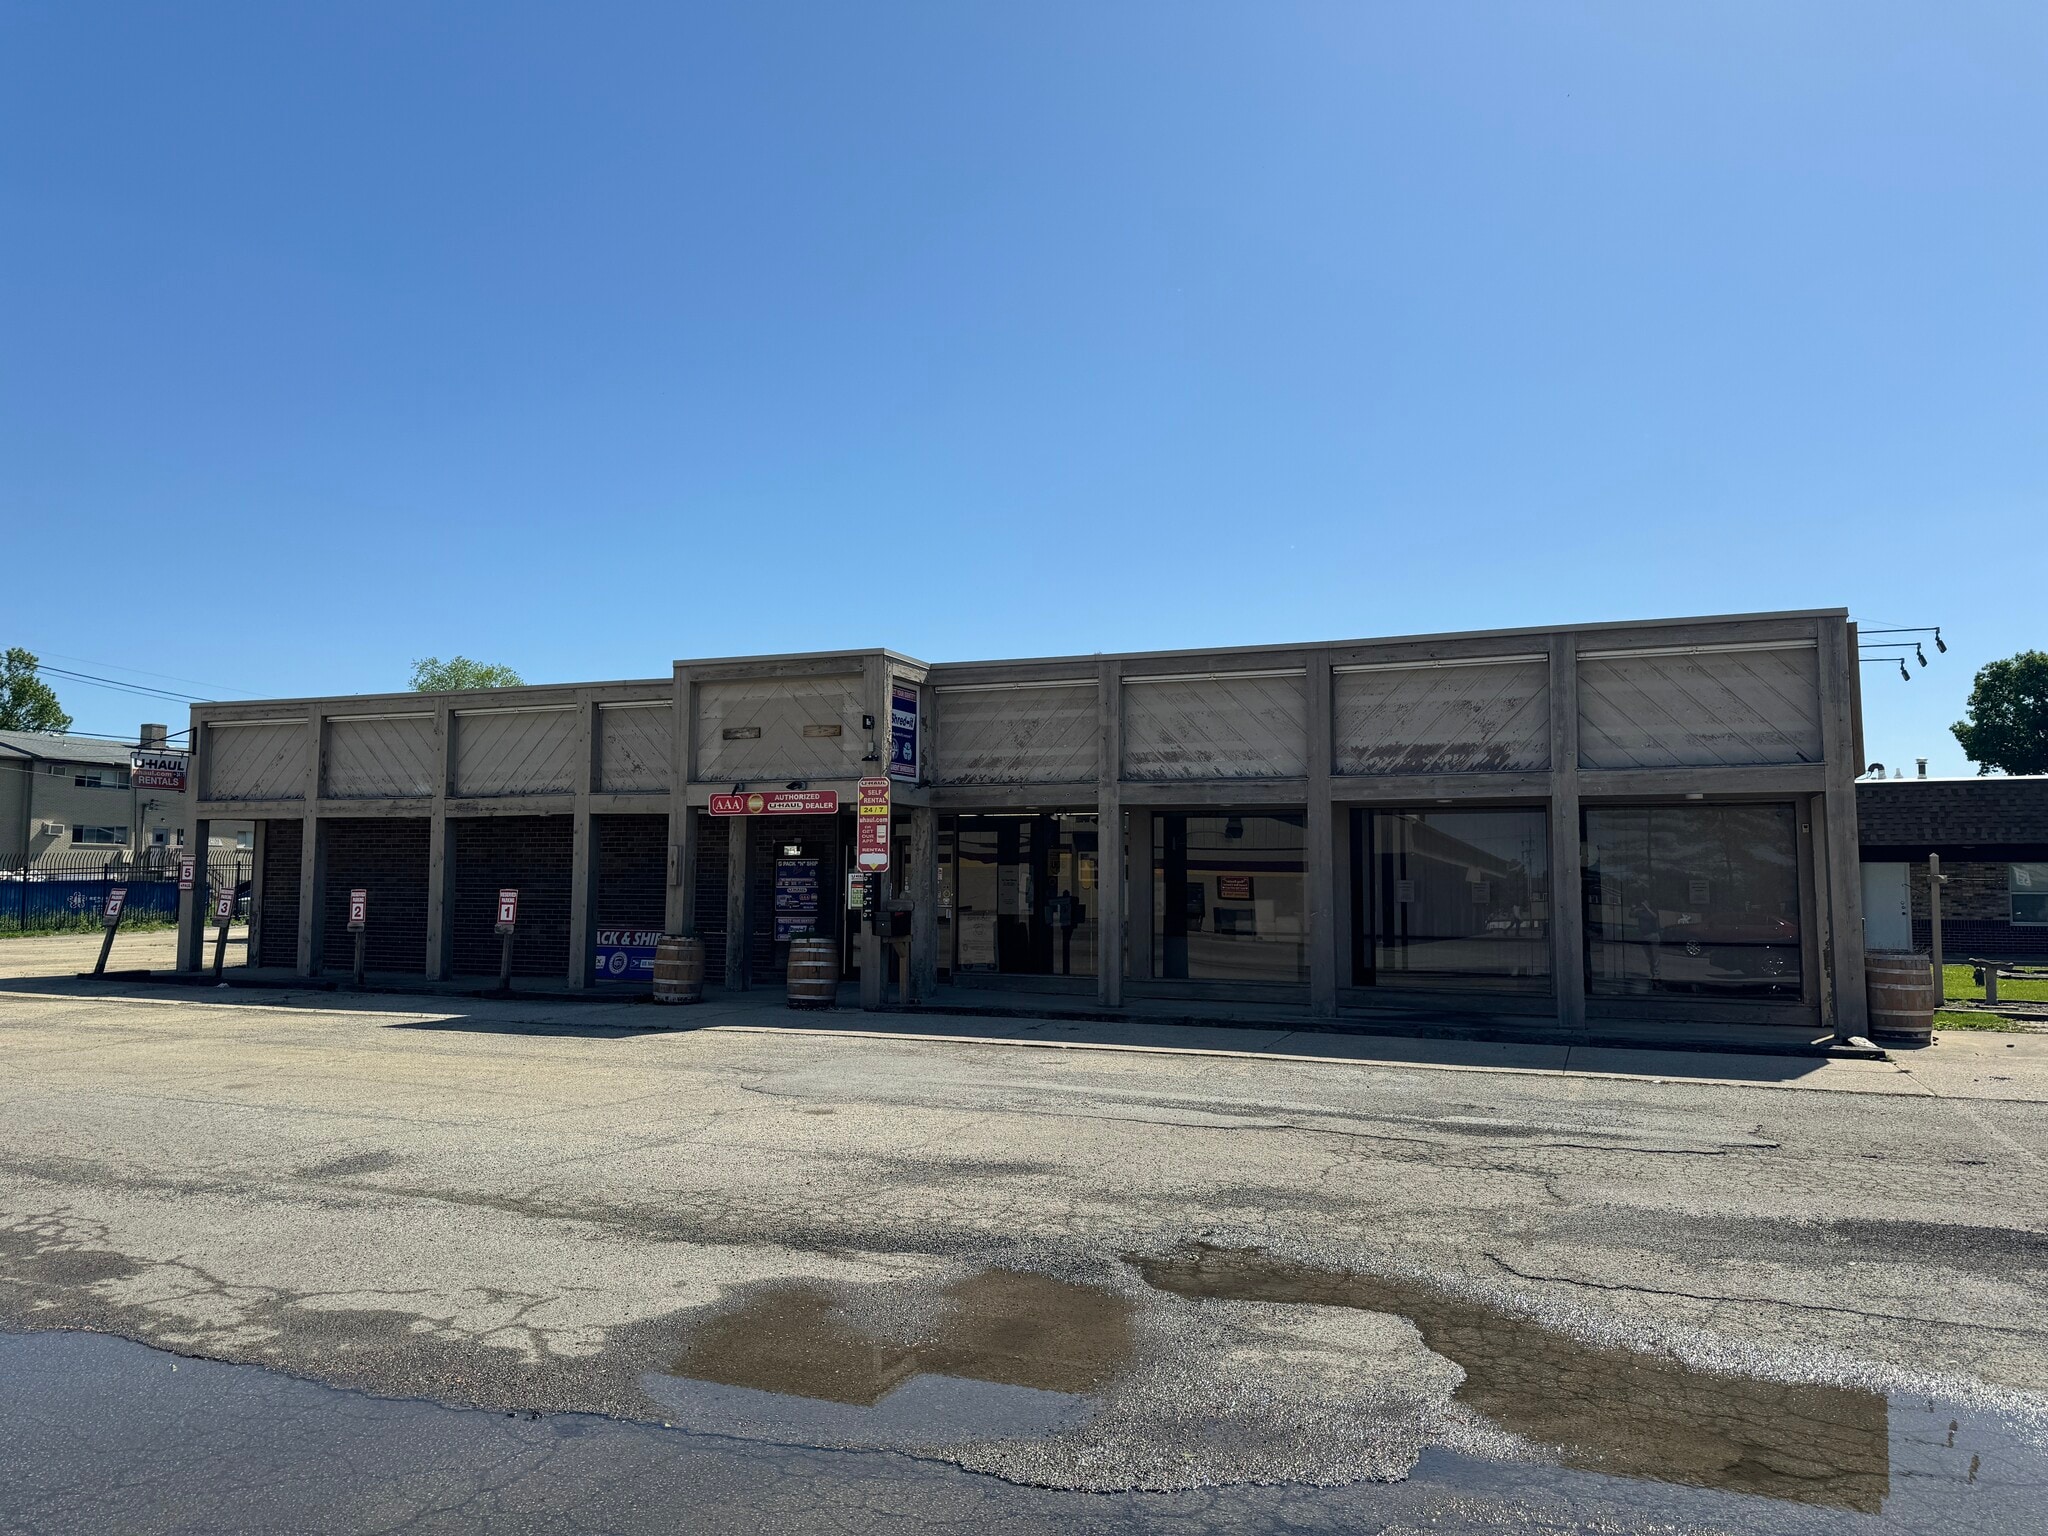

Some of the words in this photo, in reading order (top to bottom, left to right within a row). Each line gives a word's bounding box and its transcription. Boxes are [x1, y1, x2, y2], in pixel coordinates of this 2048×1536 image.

[134, 758, 185, 771] U-HAUL
[138, 776, 179, 786] RENTALS
[774, 793, 820, 801] AUTHORIZED
[715, 799, 740, 810] AAA
[184, 868, 191, 878] 5
[220, 902, 229, 914] 3
[354, 906, 361, 918] 2
[504, 906, 511, 919] 1
[620, 931, 631, 946] &
